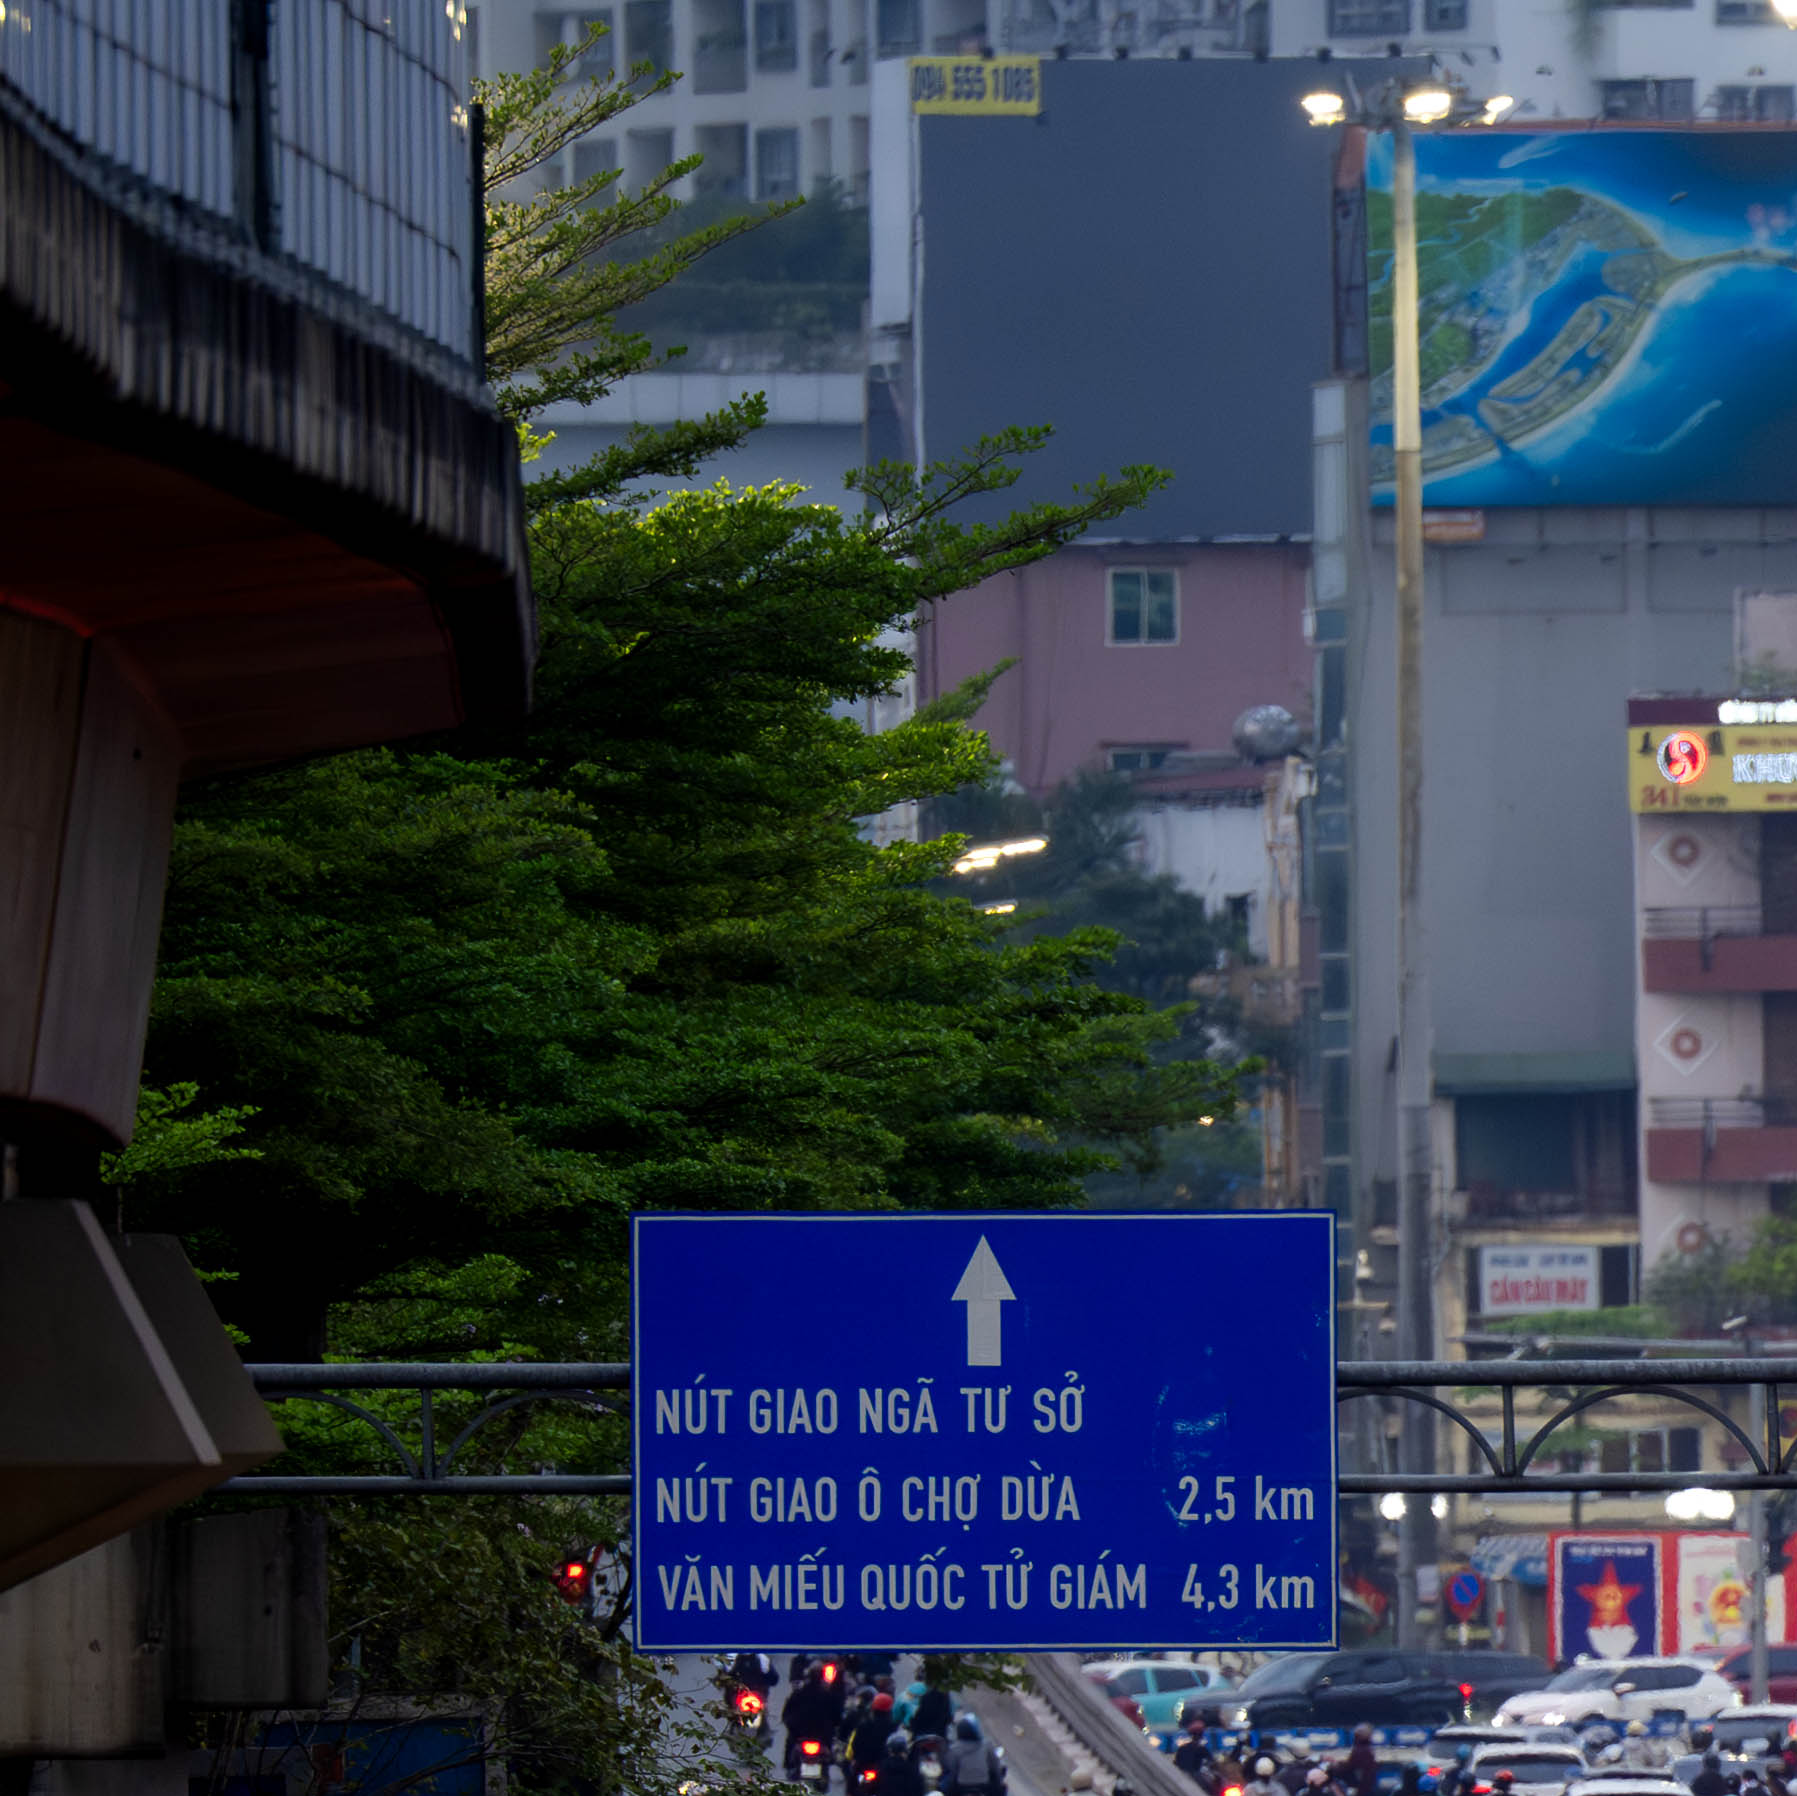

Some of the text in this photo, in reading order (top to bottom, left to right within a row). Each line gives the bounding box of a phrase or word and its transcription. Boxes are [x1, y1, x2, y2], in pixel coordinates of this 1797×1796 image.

[656, 1370, 1085, 1434] NÚT GIAO NGÃ TƯ SỞ
[656, 1460, 1314, 1530] NÚT GIAO Ô CHỢ DỪA 2,5 km
[658, 1546, 1314, 1612] VĂN MIẾU QUỐC TỬ GIÁM 4,3 km
